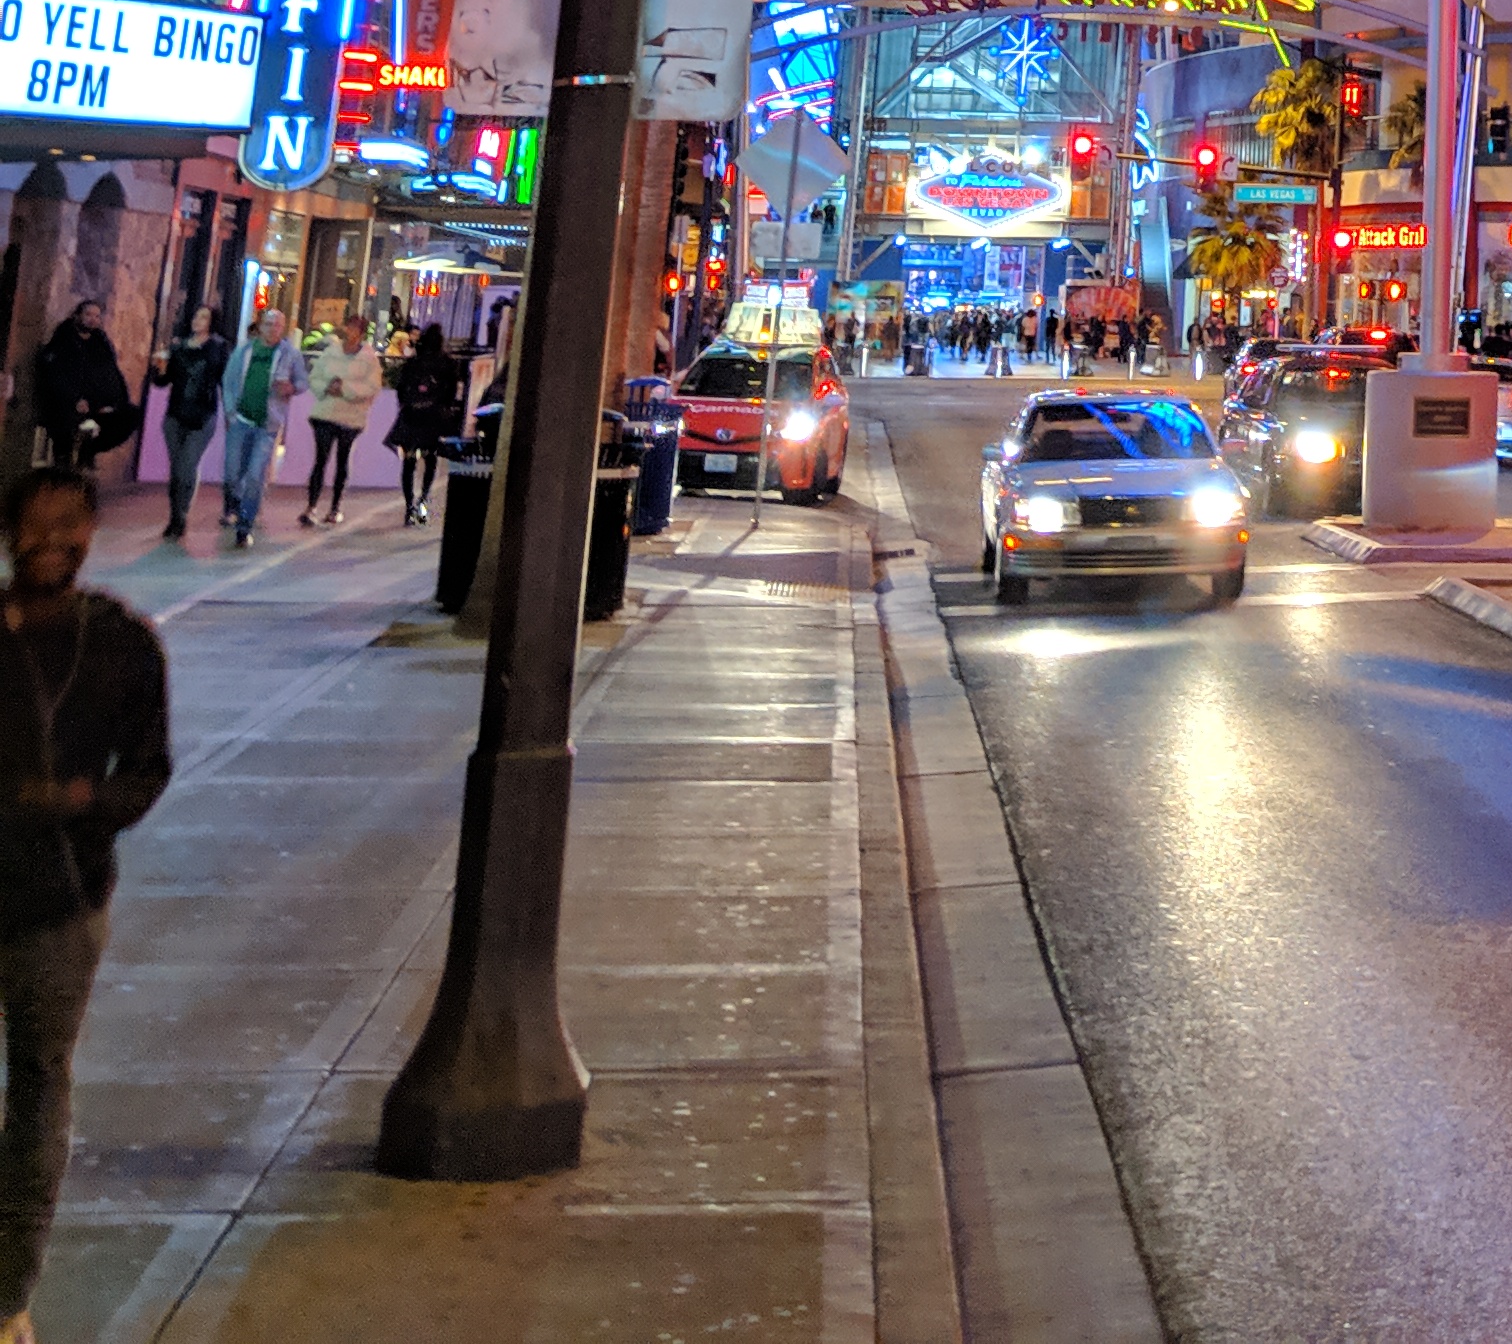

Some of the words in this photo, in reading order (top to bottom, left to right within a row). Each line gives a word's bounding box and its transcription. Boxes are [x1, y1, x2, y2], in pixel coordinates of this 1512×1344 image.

[45, 2, 129, 54] YELL
[154, 15, 259, 66] BINGO
[27, 59, 111, 109] 8PM
[927, 185, 1049, 200] DOWNTOWN
[1250, 188, 1267, 199] LAS
[1269, 189, 1296, 200] VEGAS
[942, 197, 974, 208] LAS
[977, 197, 1035, 209] VEGAS
[963, 209, 1013, 218] NEVADA
[1358, 226, 1395, 247] Attack
[1398, 226, 1426, 247] Gril
